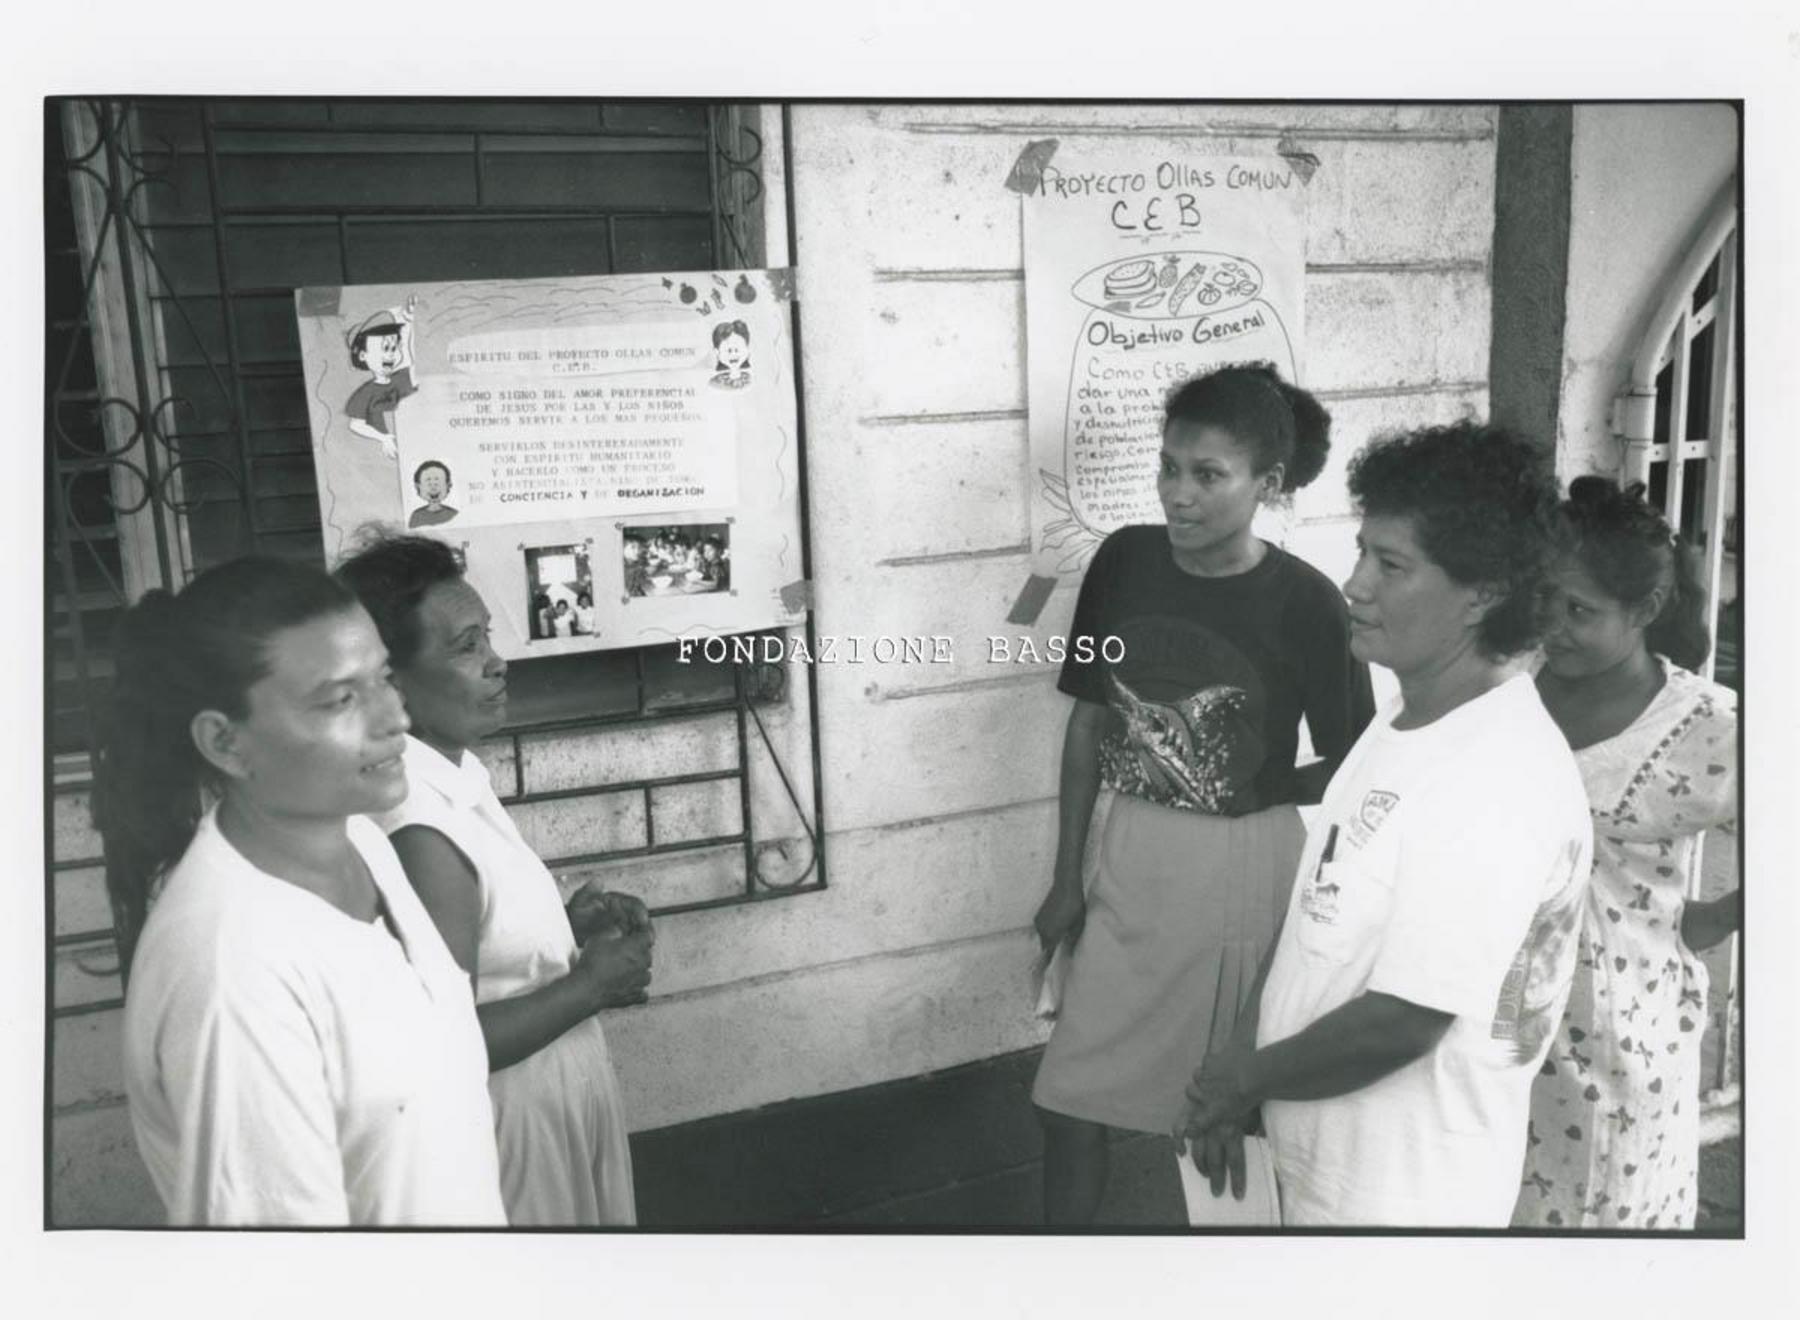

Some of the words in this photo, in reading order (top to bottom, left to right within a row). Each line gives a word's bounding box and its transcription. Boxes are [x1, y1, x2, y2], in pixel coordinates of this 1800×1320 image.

[1040, 166, 1145, 198] PROYECTO
[1227, 164, 1293, 189] COMUN
[1087, 320, 1183, 350] Objetivo
[1192, 310, 1266, 344] General
[450, 351, 512, 363] ESPIRITU
[518, 351, 541, 361] DEL
[549, 349, 609, 360] PROYECTO
[615, 348, 651, 359] OLLAS
[659, 347, 696, 357] COMUN
[1088, 356, 1145, 380] Como
[459, 391, 492, 401] COMO
[499, 390, 537, 400] SIGNO
[544, 389, 566, 399] DEL
[574, 388, 604, 399] AMOR
[1077, 380, 1114, 399] dar
[1117, 386, 1151, 399] una
[476, 404, 492, 414] DE
[502, 403, 537, 413] JESUS
[545, 403, 567, 412] POR
[574, 402, 597, 412] LAS
[604, 402, 611, 411] Y
[619, 401, 641, 411] LOS
[1079, 404, 1092, 415] a
[1097, 400, 1116, 415] la
[449, 416, 511, 428] QUEREMOS
[518, 415, 562, 425] SERVIR
[571, 415, 578, 424] A
[586, 414, 608, 424] LOS
[1074, 432, 1094, 445] de
[494, 455, 517, 465] CON
[590, 451, 671, 462] HUMANITARIO
[491, 468, 498, 478] Y
[506, 466, 559, 477] HACERLO
[499, 491, 573, 503] CONCIENCIA
[580, 490, 588, 500] Y
